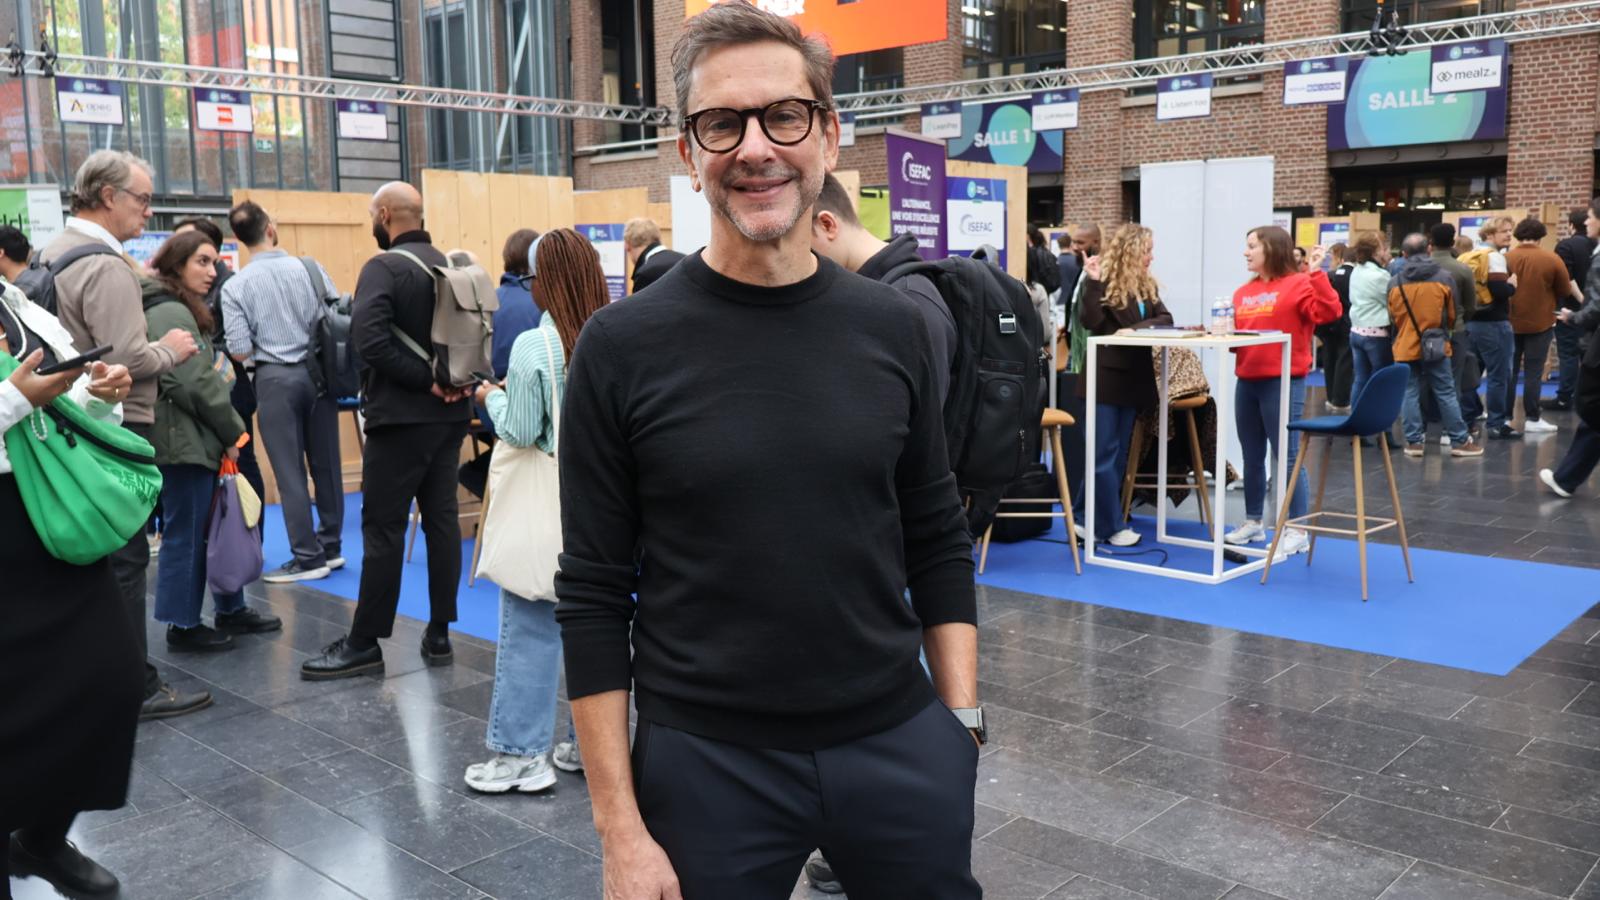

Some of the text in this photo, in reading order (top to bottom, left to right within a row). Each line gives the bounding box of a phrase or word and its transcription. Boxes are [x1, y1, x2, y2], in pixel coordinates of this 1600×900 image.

[1368, 88, 1435, 110] SALLE
[974, 128, 1031, 148] SALLE 1
[909, 163, 931, 180] ISEFAC
[968, 222, 993, 232] ISEFAC
